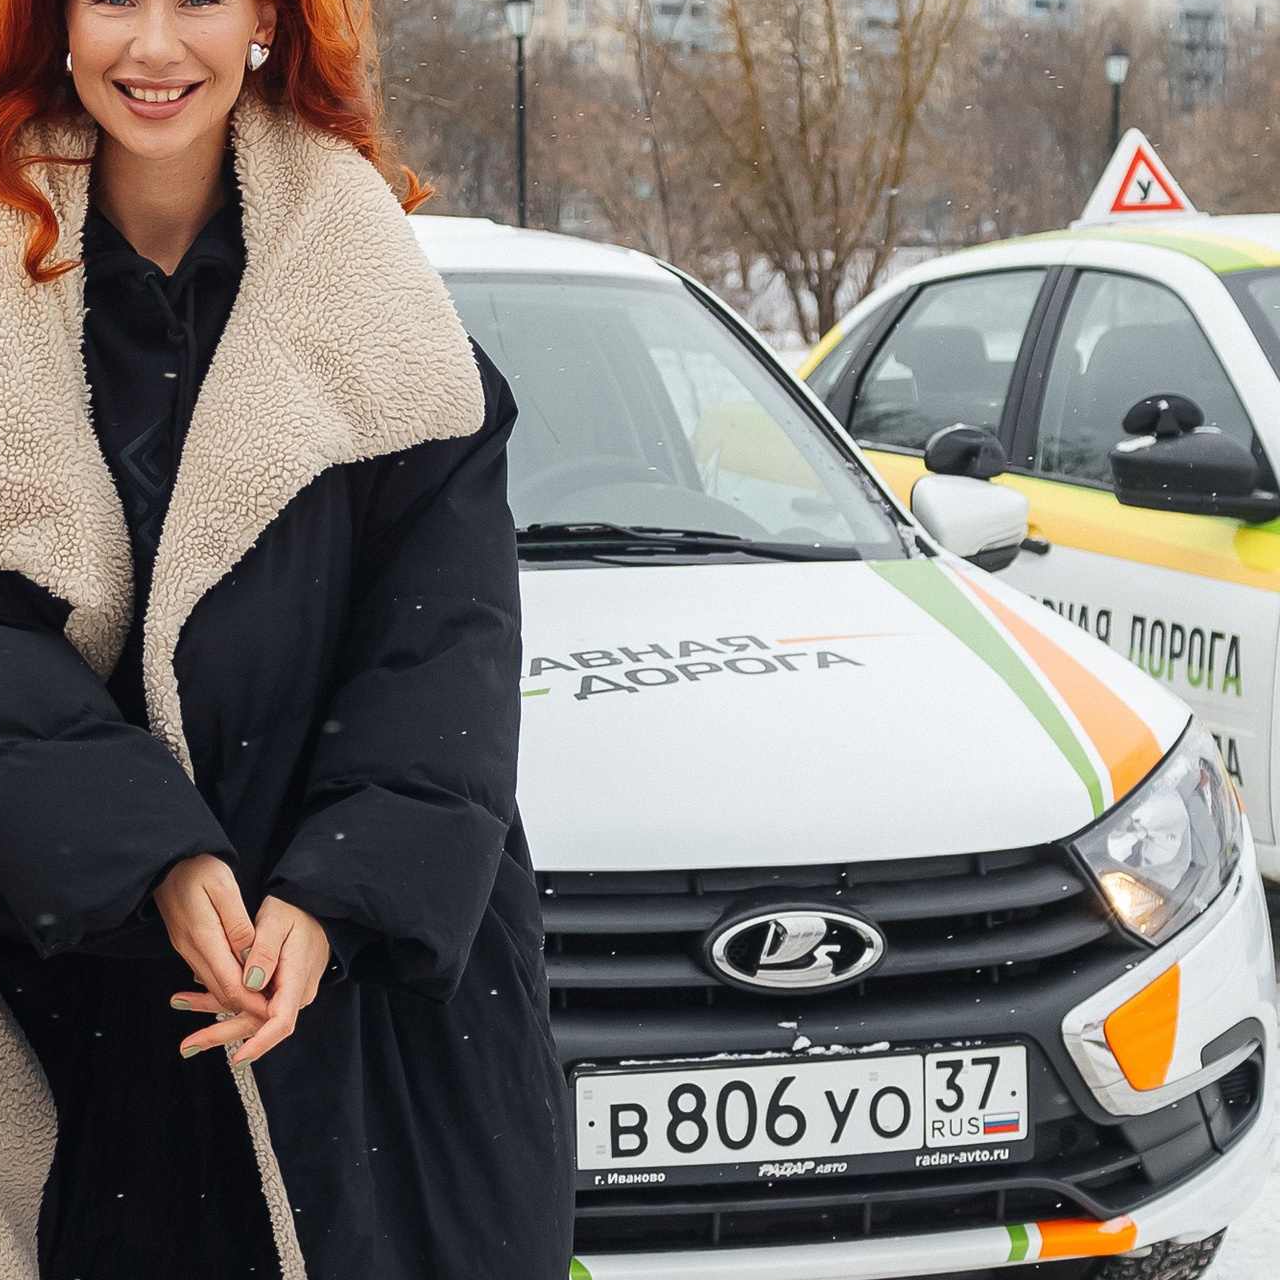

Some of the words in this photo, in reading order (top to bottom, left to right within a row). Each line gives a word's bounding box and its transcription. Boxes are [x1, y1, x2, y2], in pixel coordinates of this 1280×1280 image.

[1136, 179, 1152, 202] У
[520, 635, 773, 679] АВНАЯ
[1128, 614, 1242, 698] ДОРОГА
[573, 651, 866, 702] ДОРОГА
[610, 1076, 911, 1158] В806УО
[935, 1056, 1000, 1113] 37
[931, 1116, 980, 1139] RUS
[915, 1148, 1010, 1167] radar-avto.ru
[607, 1172, 666, 1185] Иваново
